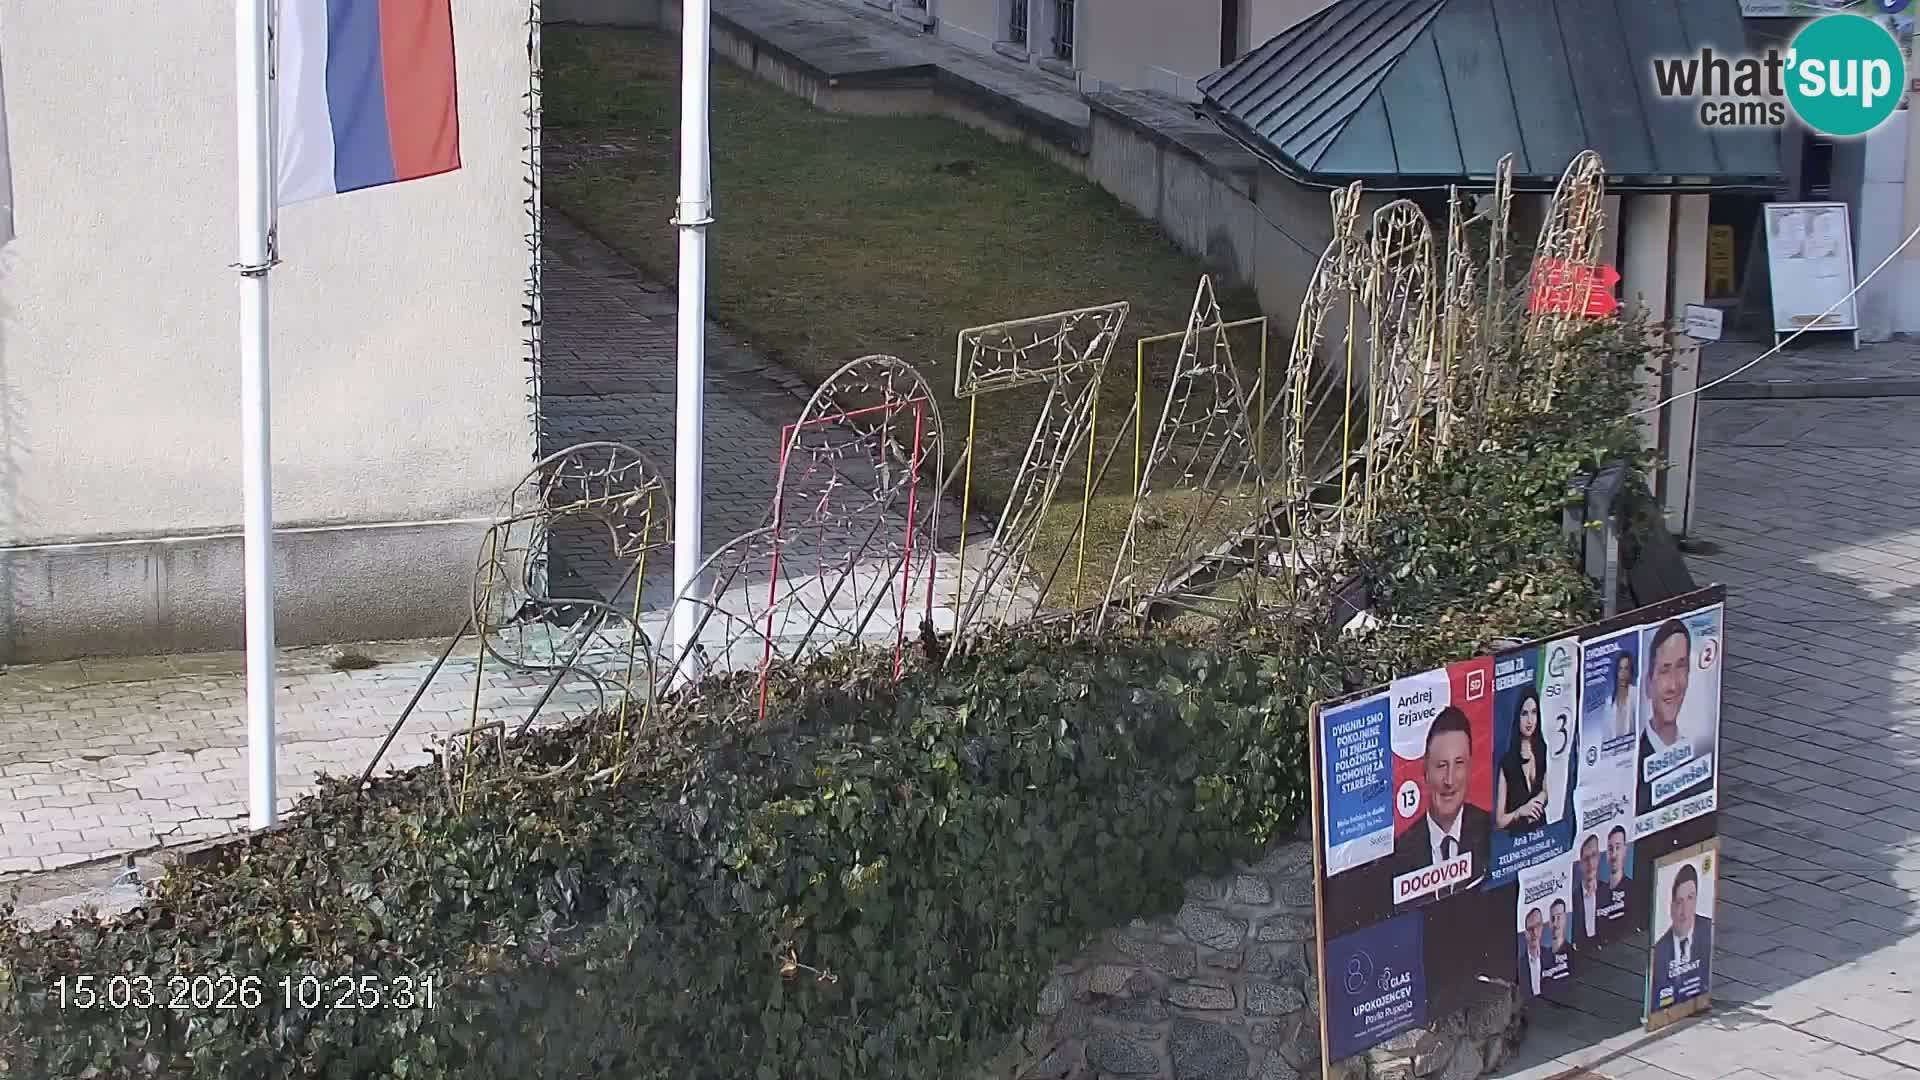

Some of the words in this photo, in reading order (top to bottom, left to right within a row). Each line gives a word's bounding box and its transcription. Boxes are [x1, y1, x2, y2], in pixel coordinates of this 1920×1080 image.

[1398, 687, 1433, 709] Andrej
[1332, 715, 1366, 737] DVIGNILI
[1366, 711, 1384, 727] SMO
[1398, 707, 1436, 727] Erjavec
[1336, 724, 1381, 748] POKOJNINE
[1554, 713, 1568, 756] 3
[1339, 746, 1350, 758] IN
[1350, 737, 1379, 757] ZNIŽALI
[1335, 751, 1378, 773] POLOŽNICE
[1336, 765, 1373, 785] DOMOVIH
[1373, 761, 1385, 774] ZA
[1402, 790, 1416, 809] 13
[1682, 796, 1713, 818] FOKUS
[1401, 859, 1468, 896] DOGOVOR
[1390, 971, 1410, 988] GLAS
[1353, 986, 1412, 1017] UPOKOJENCEV
